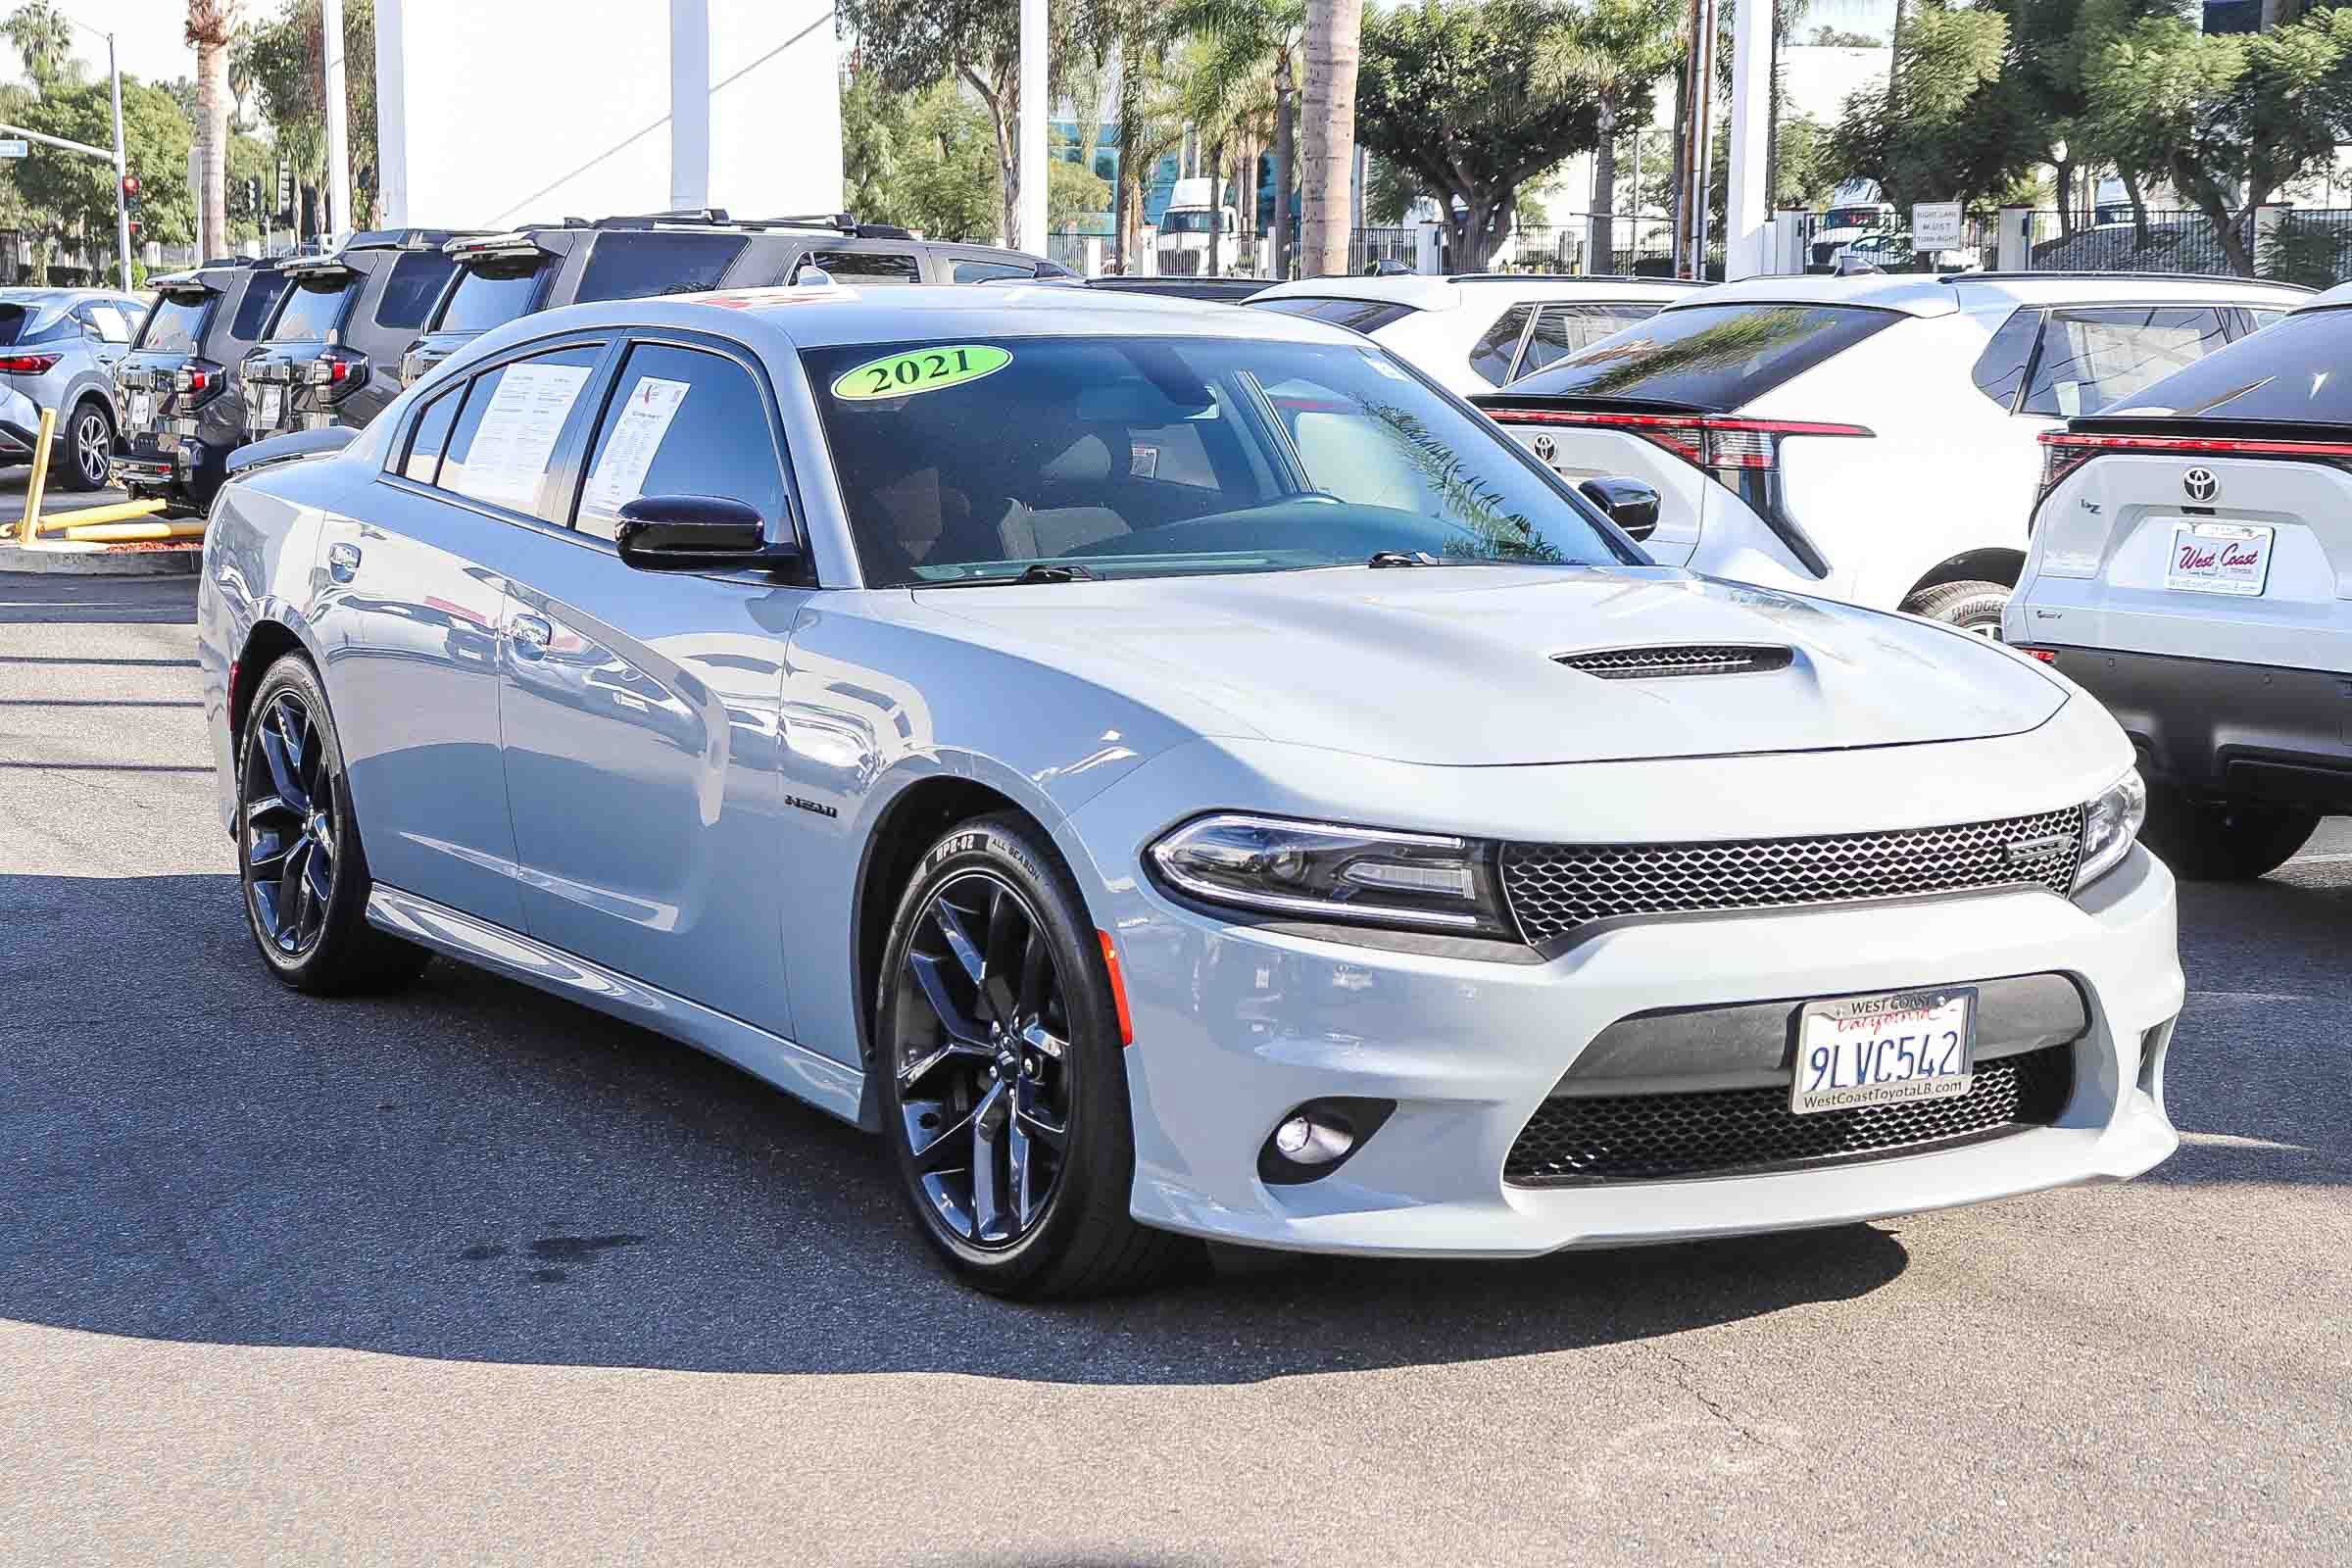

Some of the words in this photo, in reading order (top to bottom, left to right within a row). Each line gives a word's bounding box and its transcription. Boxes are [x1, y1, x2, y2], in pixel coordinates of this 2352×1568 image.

[1923, 221, 1951, 231] MUST
[866, 349, 973, 394] 2021
[2179, 546, 2216, 569] West
[2220, 542, 2259, 566] Coast
[992, 838, 1006, 852] ALL
[1007, 847, 1041, 881] SEASON
[1851, 1000, 1886, 1015] WEST
[1889, 993, 1933, 1010] COAST
[1809, 1030, 1959, 1093] 9LVC542
[1803, 1081, 1963, 1109] WestCoastToyotaLB.com
